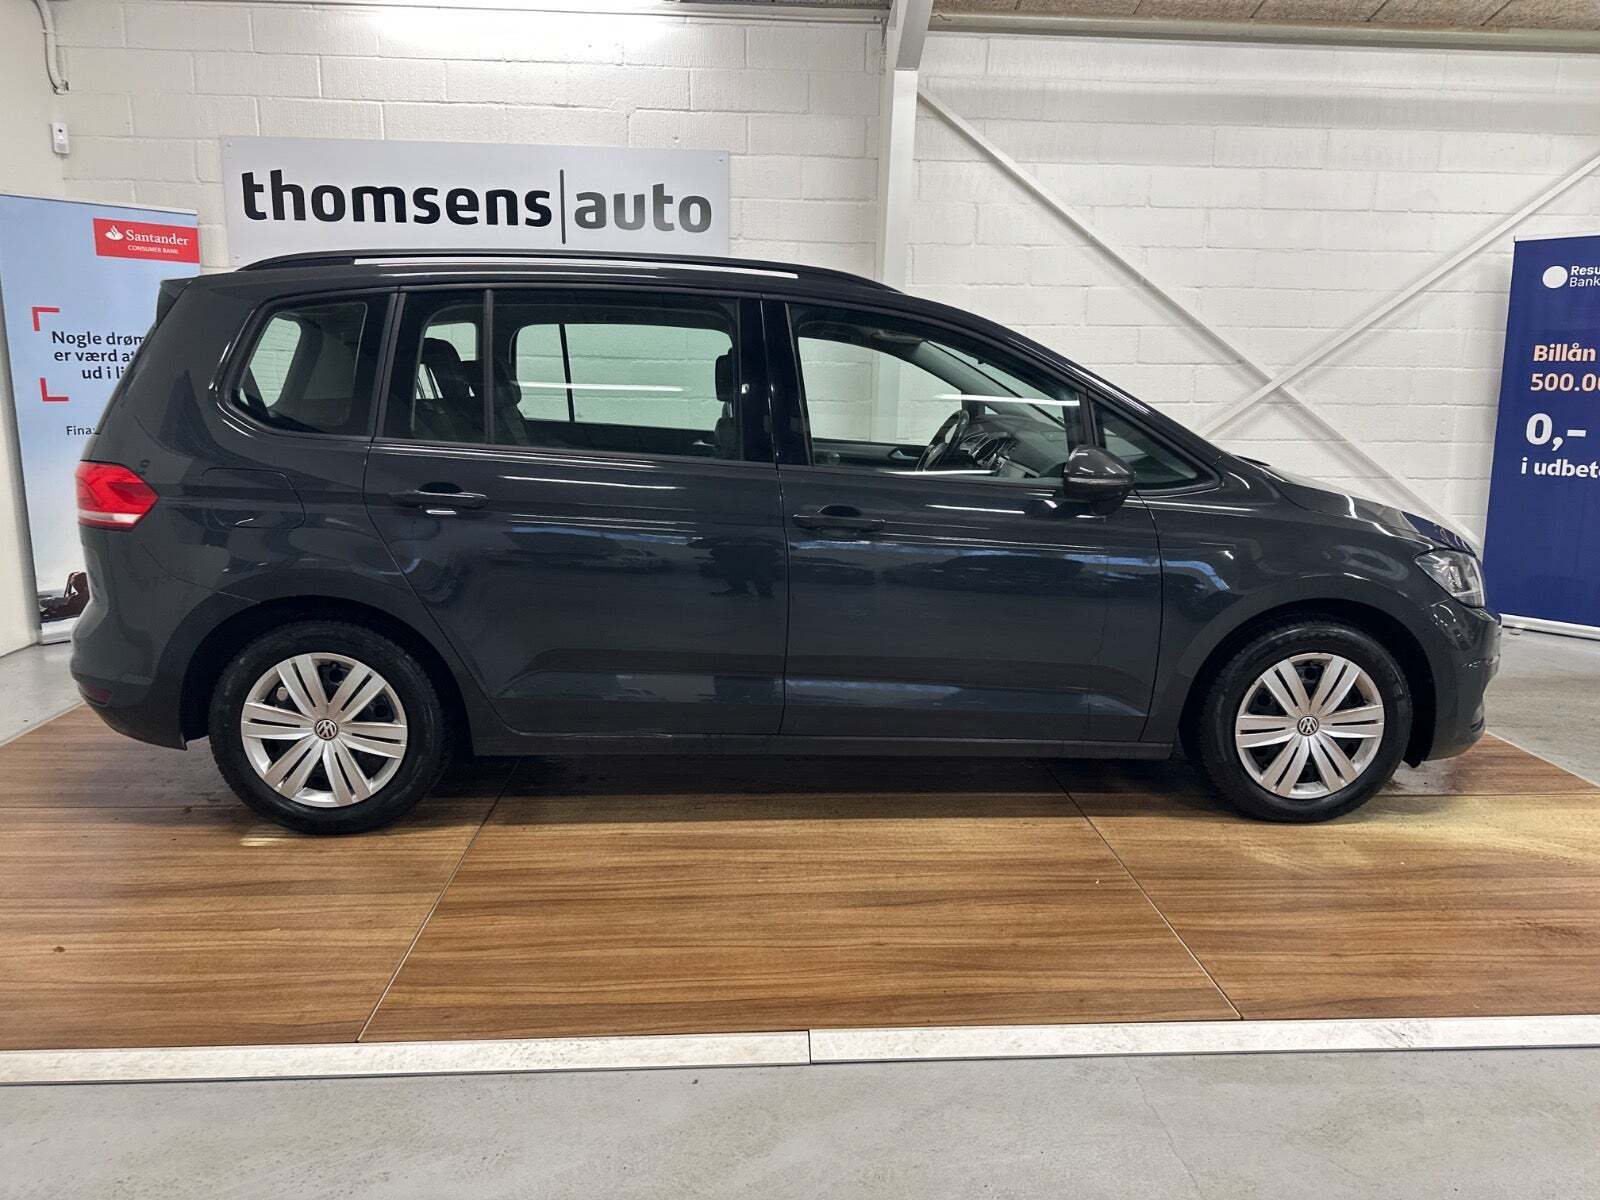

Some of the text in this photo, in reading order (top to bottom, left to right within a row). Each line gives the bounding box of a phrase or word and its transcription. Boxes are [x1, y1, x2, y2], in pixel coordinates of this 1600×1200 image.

[241, 169, 712, 234] thomsens auto
[126, 229, 189, 246] Santander
[128, 245, 161, 253] CONSUMER
[1569, 276, 1600, 288] Bank
[51, 331, 102, 349] Nogle
[54, 351, 71, 361] er
[75, 349, 118, 362] værd
[1533, 342, 1597, 362] Billån
[82, 366, 102, 379] ud
[106, 366, 112, 379] i
[1530, 373, 1600, 392] 500.0
[1521, 456, 1600, 478] i udbet
